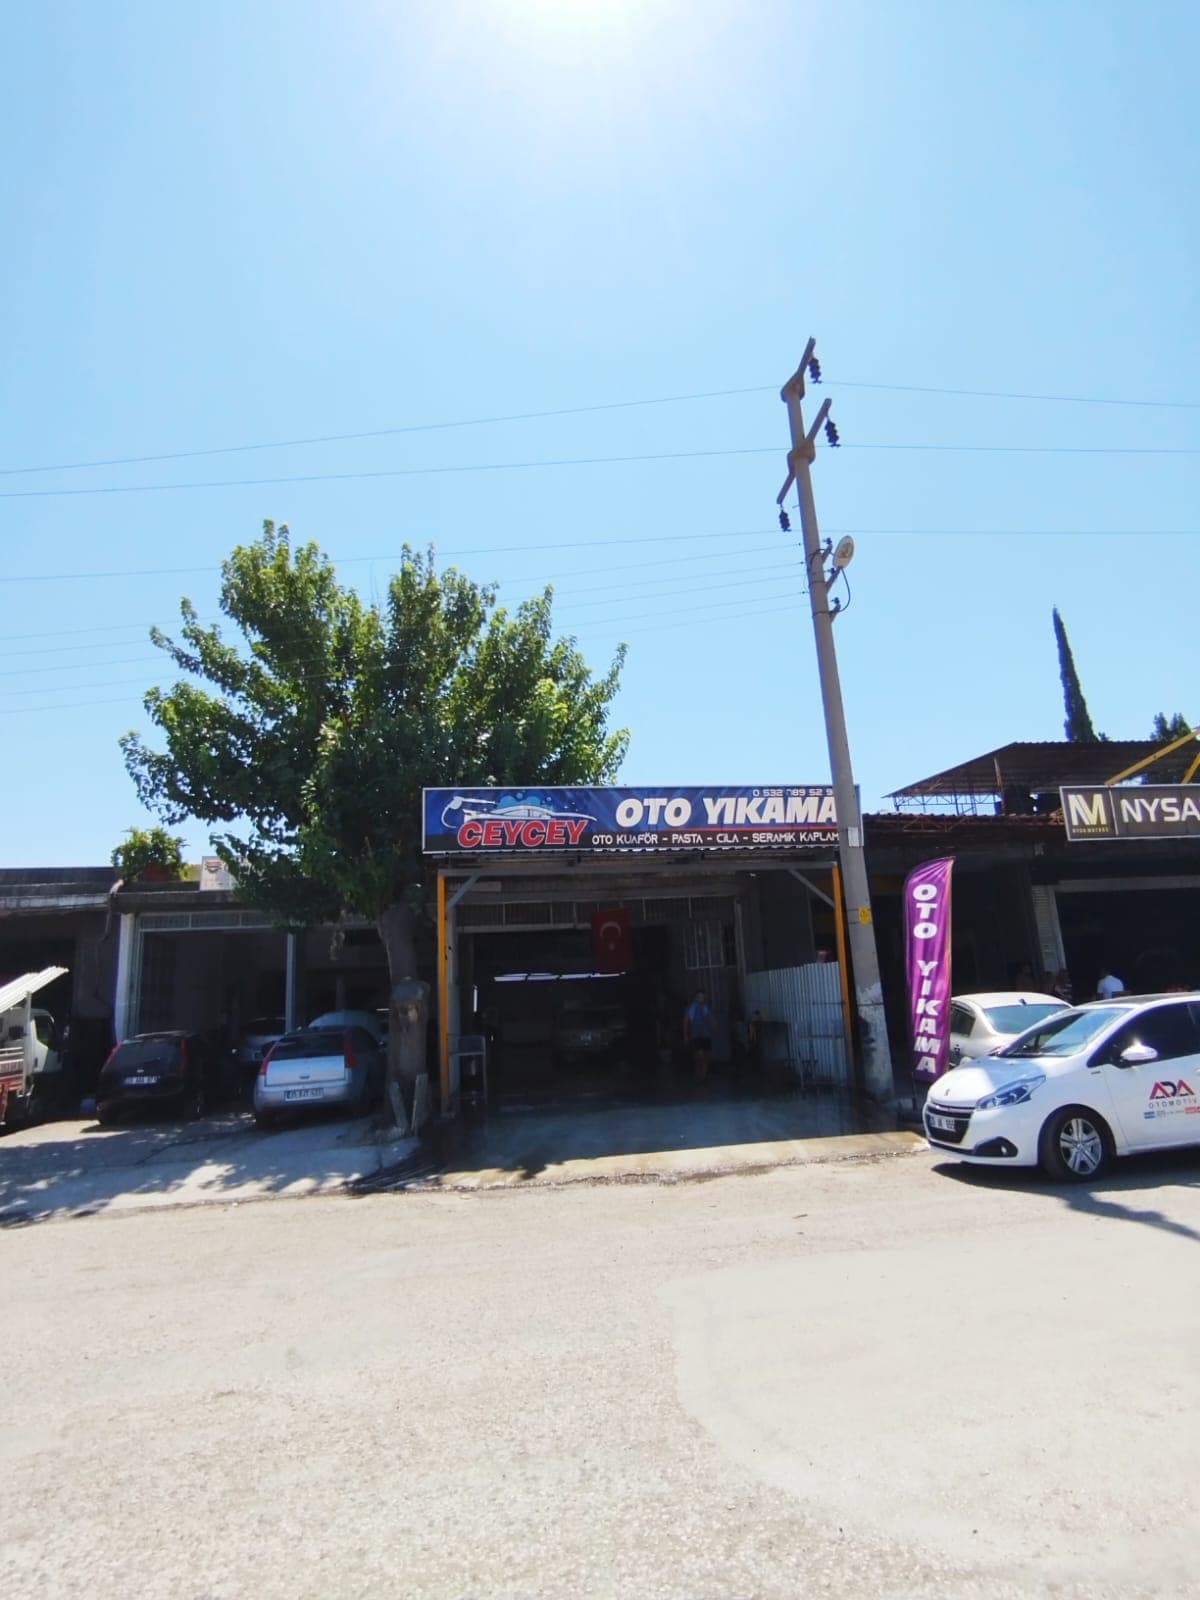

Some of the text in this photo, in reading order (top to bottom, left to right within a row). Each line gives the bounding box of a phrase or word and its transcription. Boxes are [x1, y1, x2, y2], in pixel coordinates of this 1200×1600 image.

[752, 789, 760, 797] 0
[762, 788, 783, 797] 532
[615, 795, 837, 827] OTO YIKAMA
[457, 818, 589, 848] CEYCEY
[591, 834, 613, 845] OTO
[616, 832, 658, 844] KUAFÖR
[672, 833, 703, 844] PASTA
[799, 832, 840, 842] KAPLAM
[912, 883, 938, 940] OTO
[914, 959, 943, 1074] YIKAMA
[1149, 1079, 1195, 1100] ADA
